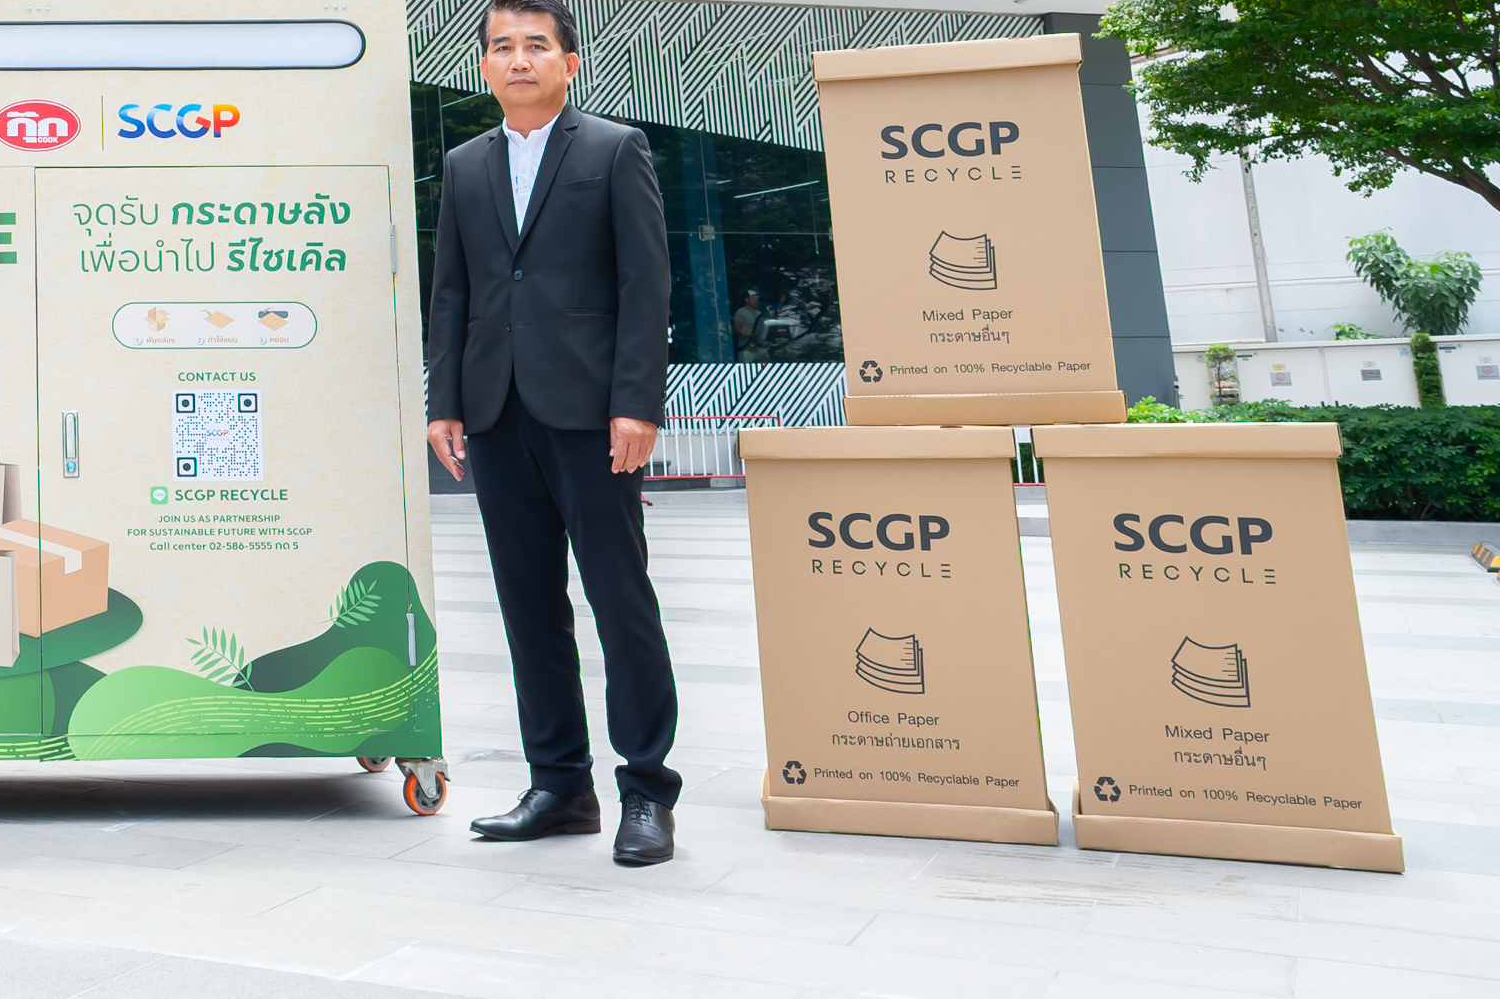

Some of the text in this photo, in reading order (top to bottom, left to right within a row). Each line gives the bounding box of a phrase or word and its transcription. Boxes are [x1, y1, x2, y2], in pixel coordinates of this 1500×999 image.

[118, 103, 240, 138] SCGP
[880, 120, 1019, 160] SCGP
[885, 165, 1022, 184] RECYCLE
[71, 192, 351, 235] จุดรับ กระดาษลัง
[79, 233, 347, 273] เพื่อนำไป รีไซเคิล
[922, 308, 1013, 324] Mixed Paper
[146, 335, 175, 344] พับกล่อง
[208, 336, 238, 344] ทำให้แบน
[929, 324, 1010, 345] กระดาษอื่นๆ
[178, 372, 256, 381] CONTACT US
[890, 360, 1091, 375] Printed on 100% Recyclable Paper
[175, 489, 288, 501] SCGP RECYCLE
[159, 515, 180, 523] JOIN
[149, 528, 215, 536] SUSTAINABLE
[807, 511, 950, 551] SCGP
[1113, 512, 1273, 555] SCGP
[150, 542, 170, 550] Call
[209, 542, 272, 550] 02-586-5555
[293, 542, 299, 550] 5
[811, 559, 952, 579] RECYCLE
[1119, 563, 1276, 585] RECYCLE
[847, 710, 940, 730] Office Paper
[831, 731, 961, 752] กระดาษถ่ายเอกสาร
[1165, 725, 1270, 745] Mixed Paper
[1173, 748, 1267, 771] กระดาษอื่นๆ
[814, 767, 1020, 791] Printed on 100% Recyclable Paper
[1129, 783, 1362, 810] Printed on 100% Recyclable Paper
